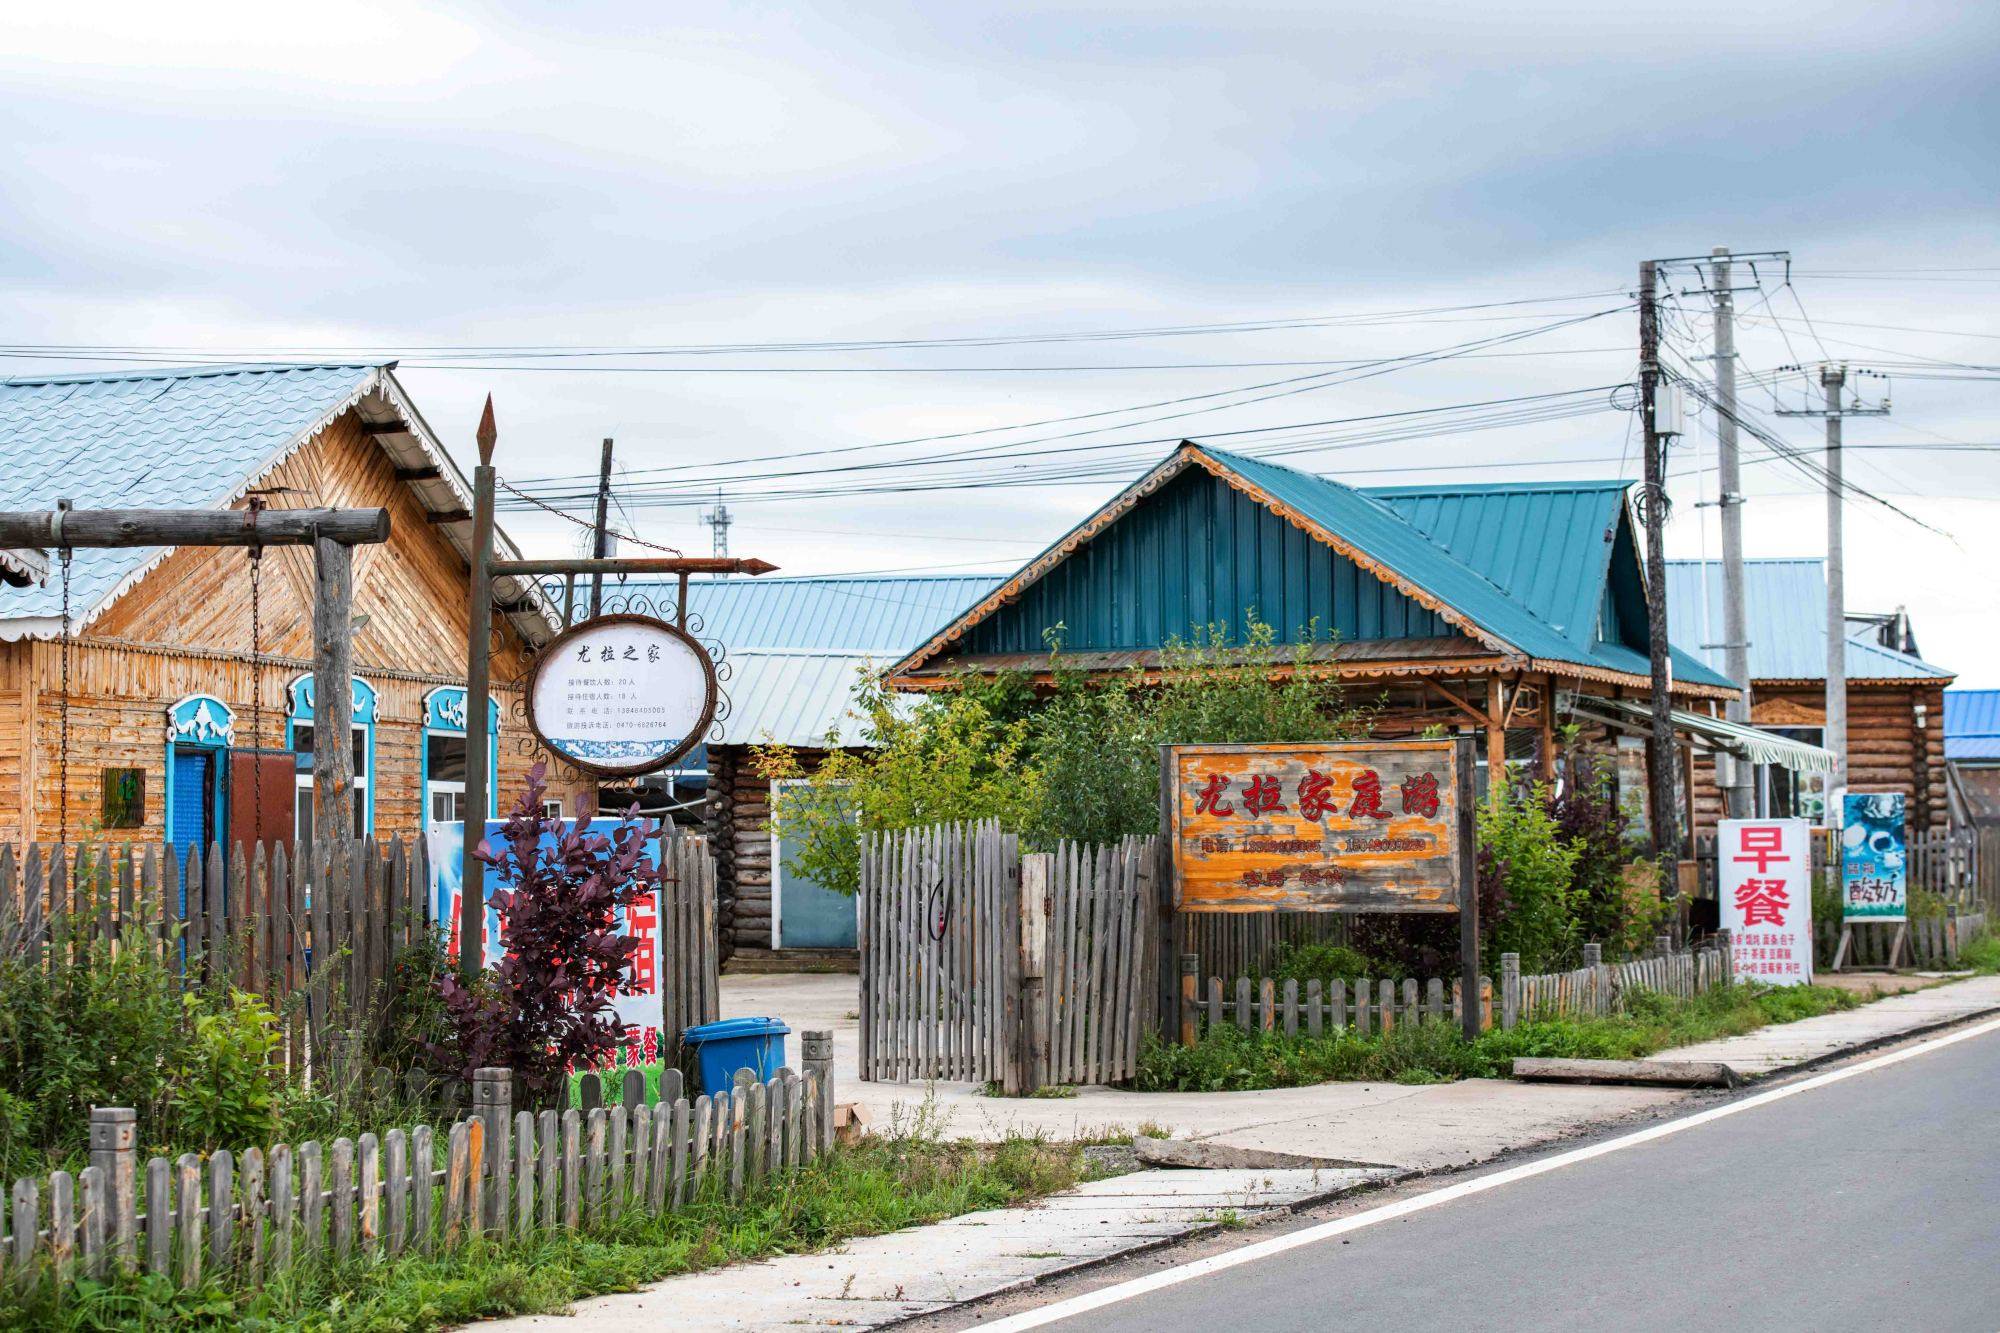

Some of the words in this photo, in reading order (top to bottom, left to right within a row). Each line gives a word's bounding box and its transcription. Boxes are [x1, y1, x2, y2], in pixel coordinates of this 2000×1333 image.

[577, 644, 661, 663] 尤拉之家
[1195, 768, 1441, 823] 尤拉家庭游
[1242, 870, 1287, 888] 客房
[1299, 868, 1346, 888] 餐饮
[1733, 827, 1791, 928] 早餐
[1849, 877, 1897, 902] 酸奶
[1780, 934, 1795, 946] 包子
